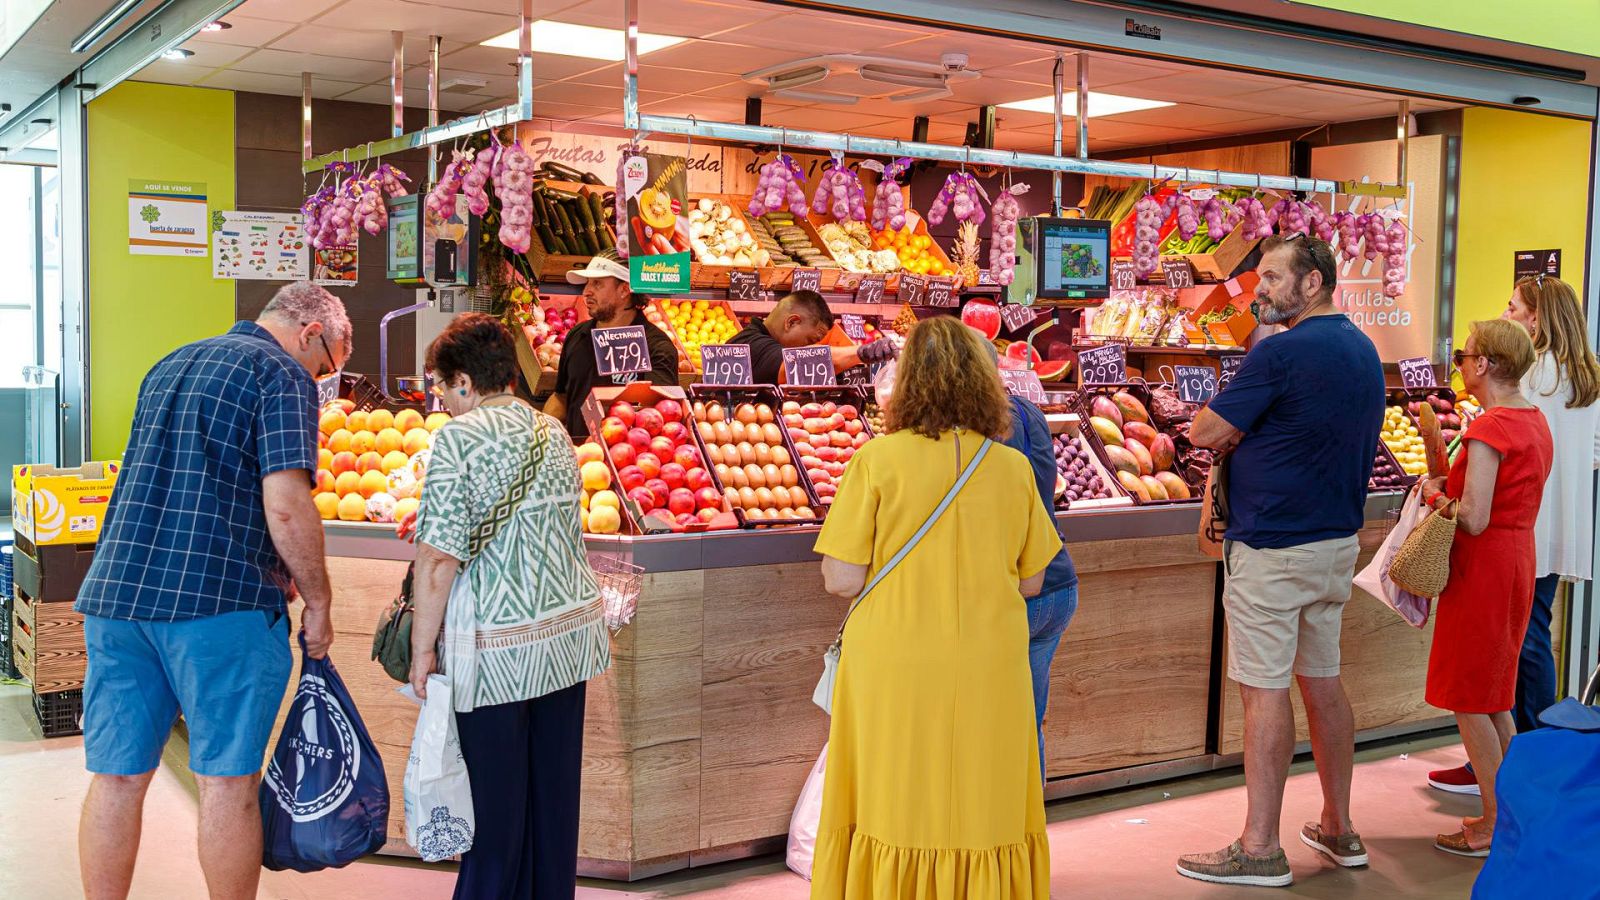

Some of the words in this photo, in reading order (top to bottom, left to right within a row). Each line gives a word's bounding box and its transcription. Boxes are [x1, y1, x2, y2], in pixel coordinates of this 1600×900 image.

[530, 137, 606, 164] Frutas
[144, 183, 161, 191] AQUÍ
[174, 227, 195, 235] zaragoza
[641, 272, 656, 282] DULCE
[661, 273, 680, 283] JUGOSO
[1341, 288, 1395, 307] frutas
[603, 331, 644, 341] NECTARINA
[1094, 347, 1114, 358] MANGO
